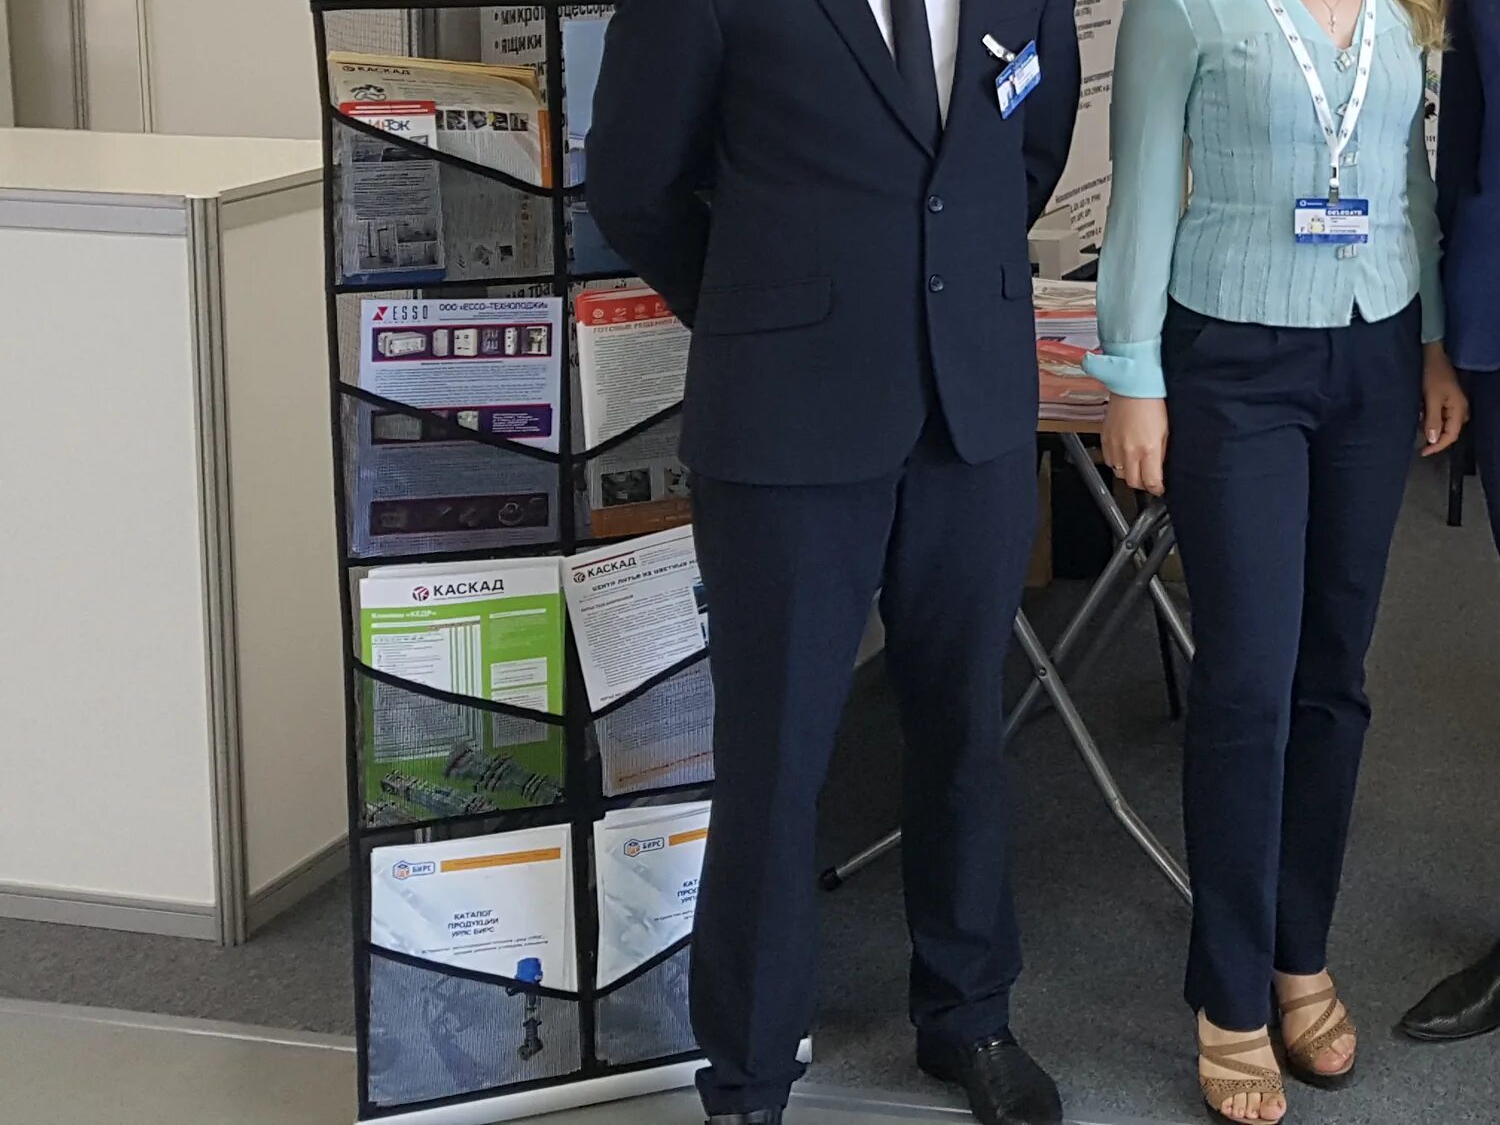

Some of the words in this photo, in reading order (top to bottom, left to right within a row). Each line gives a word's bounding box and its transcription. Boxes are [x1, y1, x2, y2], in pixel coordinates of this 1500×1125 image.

[393, 305, 428, 320] ESSO
[439, 303, 457, 311] ООО
[588, 557, 637, 577] КАСКАД
[433, 579, 504, 597] КАСКАД
[454, 910, 493, 920] КАТАЛОГ
[448, 918, 499, 930] ПРОДУКЦИИ
